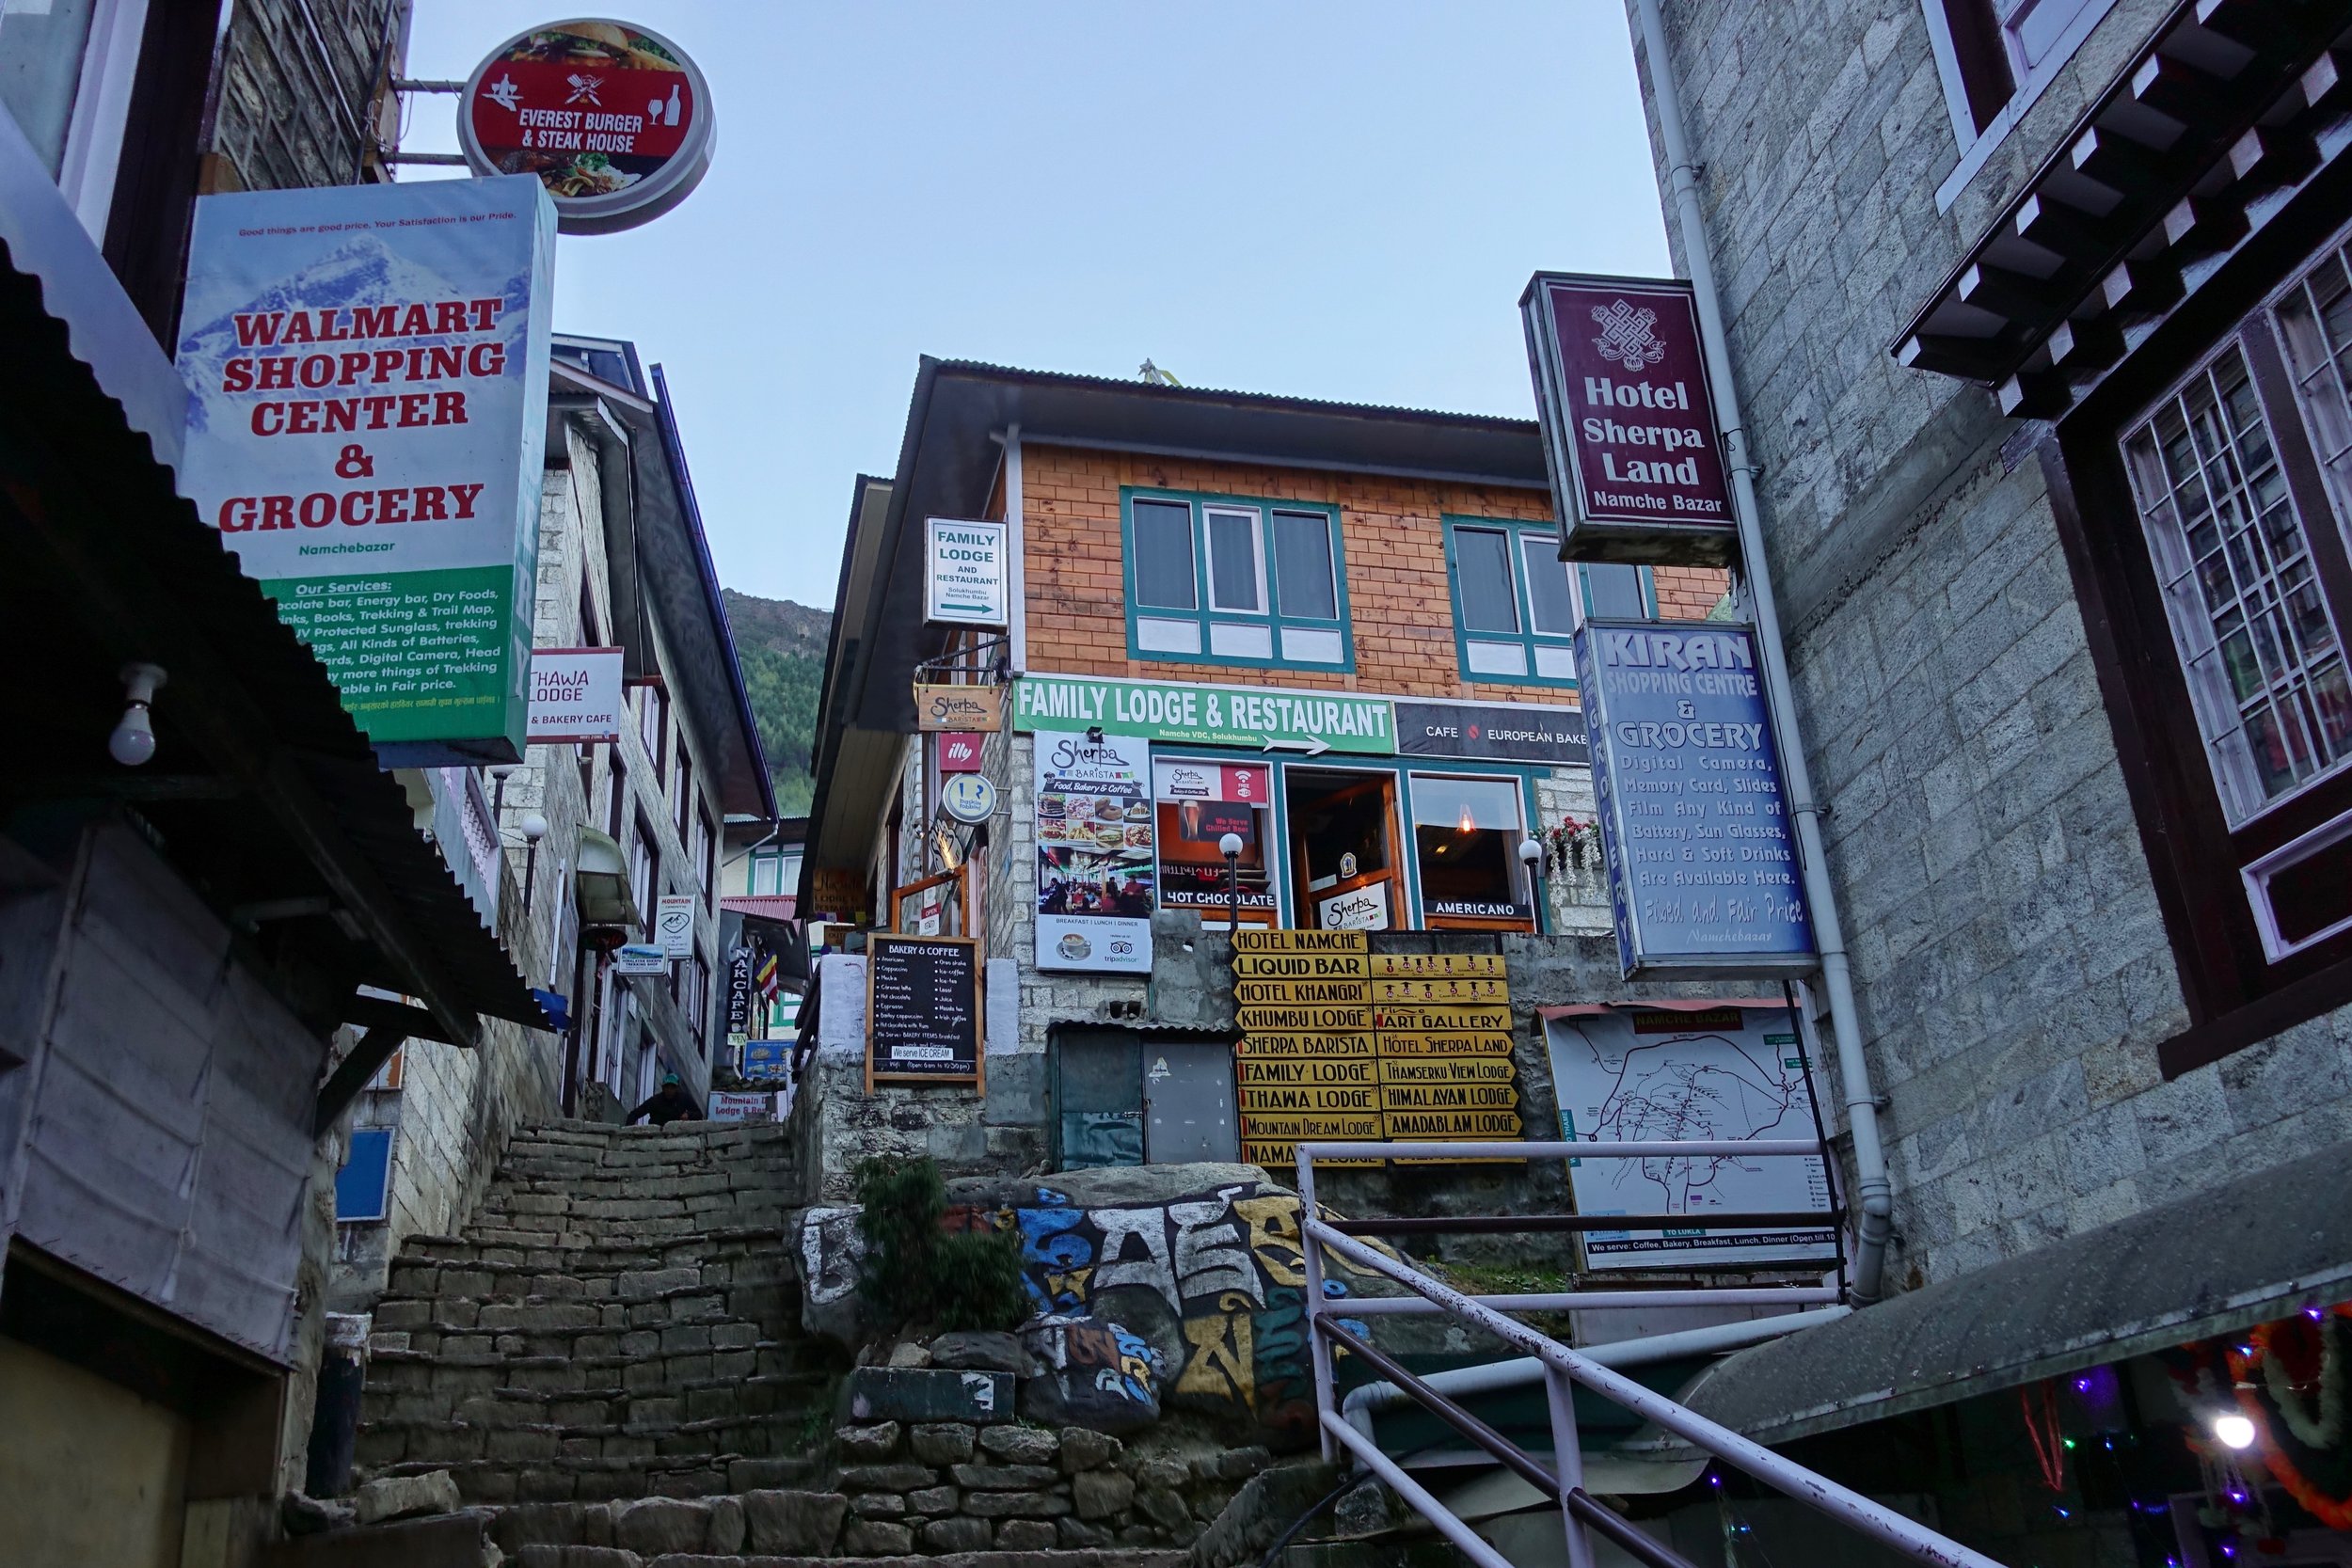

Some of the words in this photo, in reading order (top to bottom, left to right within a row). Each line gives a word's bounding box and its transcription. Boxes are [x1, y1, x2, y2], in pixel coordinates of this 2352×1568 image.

[519, 109, 582, 129] EVEREST
[585, 113, 643, 133] BURGER
[522, 130, 532, 147] &
[538, 131, 582, 150] STEAK
[586, 134, 634, 152] HOUSE
[267, 226, 297, 235] things
[318, 223, 342, 232] good
[399, 216, 455, 226] Satisfaction
[234, 298, 502, 346] WALMART
[223, 342, 506, 393] SHOPPING
[1584, 377, 1689, 410] Hotel
[251, 391, 469, 436] CENTER
[1582, 418, 1705, 452] Sherpa
[335, 444, 374, 479] &
[1602, 453, 1699, 485] Land
[218, 483, 484, 533] GROCERY
[1594, 491, 1666, 509] Namche
[1673, 495, 1722, 513] Bazar
[938, 531, 994, 546] FAMILY
[299, 542, 396, 556] Namchebazar
[940, 548, 993, 562] LODGE
[295, 583, 324, 595] Our
[328, 580, 391, 593] Services:
[937, 574, 998, 585] RESTAURANT
[328, 598, 352, 609] bar,
[357, 596, 401, 609] Energy
[405, 594, 428, 605] bar,
[433, 593, 454, 604] Dry
[459, 589, 499, 601] Foods,
[314, 612, 356, 624] Books,
[359, 610, 414, 622] Trekking
[418, 608, 427, 617] &
[432, 606, 459, 615] Trail
[463, 604, 495, 615] Map,
[314, 625, 376, 637] Protected
[380, 622, 440, 635] Sunglass,
[445, 619, 497, 632] trekking
[341, 640, 358, 650] All
[361, 638, 397, 649] Kinds
[402, 636, 416, 647] of
[420, 634, 480, 645] Batteries,
[359, 653, 403, 664] Digital
[406, 650, 461, 660] Camera,
[465, 647, 501, 657] Head
[1601, 633, 1753, 673] KIRAN
[342, 669, 377, 679] more
[382, 666, 421, 677] things
[425, 664, 440, 673] of
[444, 662, 497, 675] Trekking
[1609, 672, 1692, 694] SHOPPING
[1695, 673, 1757, 698] CENTRE
[930, 697, 987, 717] Sherpa
[1019, 682, 1107, 721] FAMILY
[1116, 689, 1198, 726] LODGE
[1206, 694, 1223, 728] &
[1231, 695, 1387, 737] RESTAURANT
[1677, 699, 1696, 720] &
[542, 715, 583, 723] BAKERY
[1159, 729, 1189, 738] Namche
[1193, 731, 1210, 739] VDC,
[1212, 732, 1257, 743] Solukhumbu
[1426, 726, 1458, 737] CAFE
[1488, 730, 1552, 743] EUROPEAN
[1616, 721, 1763, 752] GROCERY
[948, 743, 972, 762] illy
[1051, 739, 1130, 769] Sherpa
[1620, 755, 1684, 772] Digital
[1698, 755, 1772, 771] Camera,
[1054, 782, 1073, 790] Food,
[1074, 783, 1100, 793] Bakery
[1108, 784, 1132, 794] Coffee
[1624, 778, 1684, 795] Memory
[1691, 777, 1728, 794] Card,
[1733, 778, 1777, 793] Slides
[1628, 800, 1663, 816] Film
[1675, 801, 1707, 818] Any
[1717, 800, 1755, 816] Kind
[1766, 801, 1781, 816] of
[1632, 824, 1692, 841] Battery,
[1695, 824, 1724, 838] Sun
[1727, 824, 1786, 839] Glasses,
[1636, 847, 1675, 863] Hard
[1681, 848, 1693, 863] &
[1702, 848, 1734, 863] Soft
[1742, 847, 1790, 863] Drinks
[1640, 871, 1667, 887] Are
[1674, 870, 1747, 886] Available
[1754, 870, 1796, 885] Here.
[1327, 896, 1378, 926] Sherpa
[1436, 902, 1515, 915] AMERICANO
[1237, 932, 1290, 949] HOTEL
[1295, 933, 1360, 949] NAMCHE
[889, 945, 917, 954] BAKERY
[927, 947, 960, 957] COFFEE
[735, 948, 749, 977] NAK
[1238, 958, 1310, 974] LIQUID
[1315, 958, 1360, 974] BAR
[730, 981, 749, 1021] CAFE
[1241, 985, 1291, 1001] HOTEL
[1295, 985, 1362, 1001] KHANGRI
[1242, 1010, 1309, 1027] KHUMBU
[1313, 1010, 1366, 1026] LODGE
[1384, 1016, 1416, 1028] ART
[1422, 1015, 1503, 1028] GALLERY
[1636, 1015, 1691, 1025] NAMCHE
[1695, 1012, 1739, 1025] BAZAR
[1244, 1037, 1298, 1054] SHERPA
[1304, 1037, 1369, 1053] BARISTA
[1384, 1036, 1422, 1053] HOTEL
[1425, 1037, 1473, 1053] SHERPA
[1474, 1036, 1508, 1053] LAND
[1245, 1064, 1305, 1081] FAMILY
[1313, 1064, 1370, 1081] LODGE
[1386, 1062, 1447, 1080] THAMSERKU
[1449, 1062, 1475, 1078] VIEW
[1477, 1062, 1511, 1079] LODGE
[1247, 1091, 1311, 1108] THAWA
[1317, 1091, 1372, 1107] LODGE
[1389, 1088, 1467, 1106] HIMALAYAN
[1470, 1088, 1513, 1104] LODGE
[1248, 1117, 1300, 1135] MOUNTAIN
[1303, 1118, 1340, 1135] DREAM
[1342, 1118, 1375, 1135] LODGE
[1392, 1116, 1474, 1133] AMADABLAM
[1476, 1115, 1516, 1132] LODGE
[1607, 1243, 1631, 1251] serve:
[1632, 1240, 1661, 1249] Coffee,
[1662, 1239, 1692, 1249] Bakery,
[1693, 1237, 1733, 1247] Breakfast,
[1734, 1236, 1761, 1245] Lunch,
[1763, 1234, 1788, 1243] Dinner
